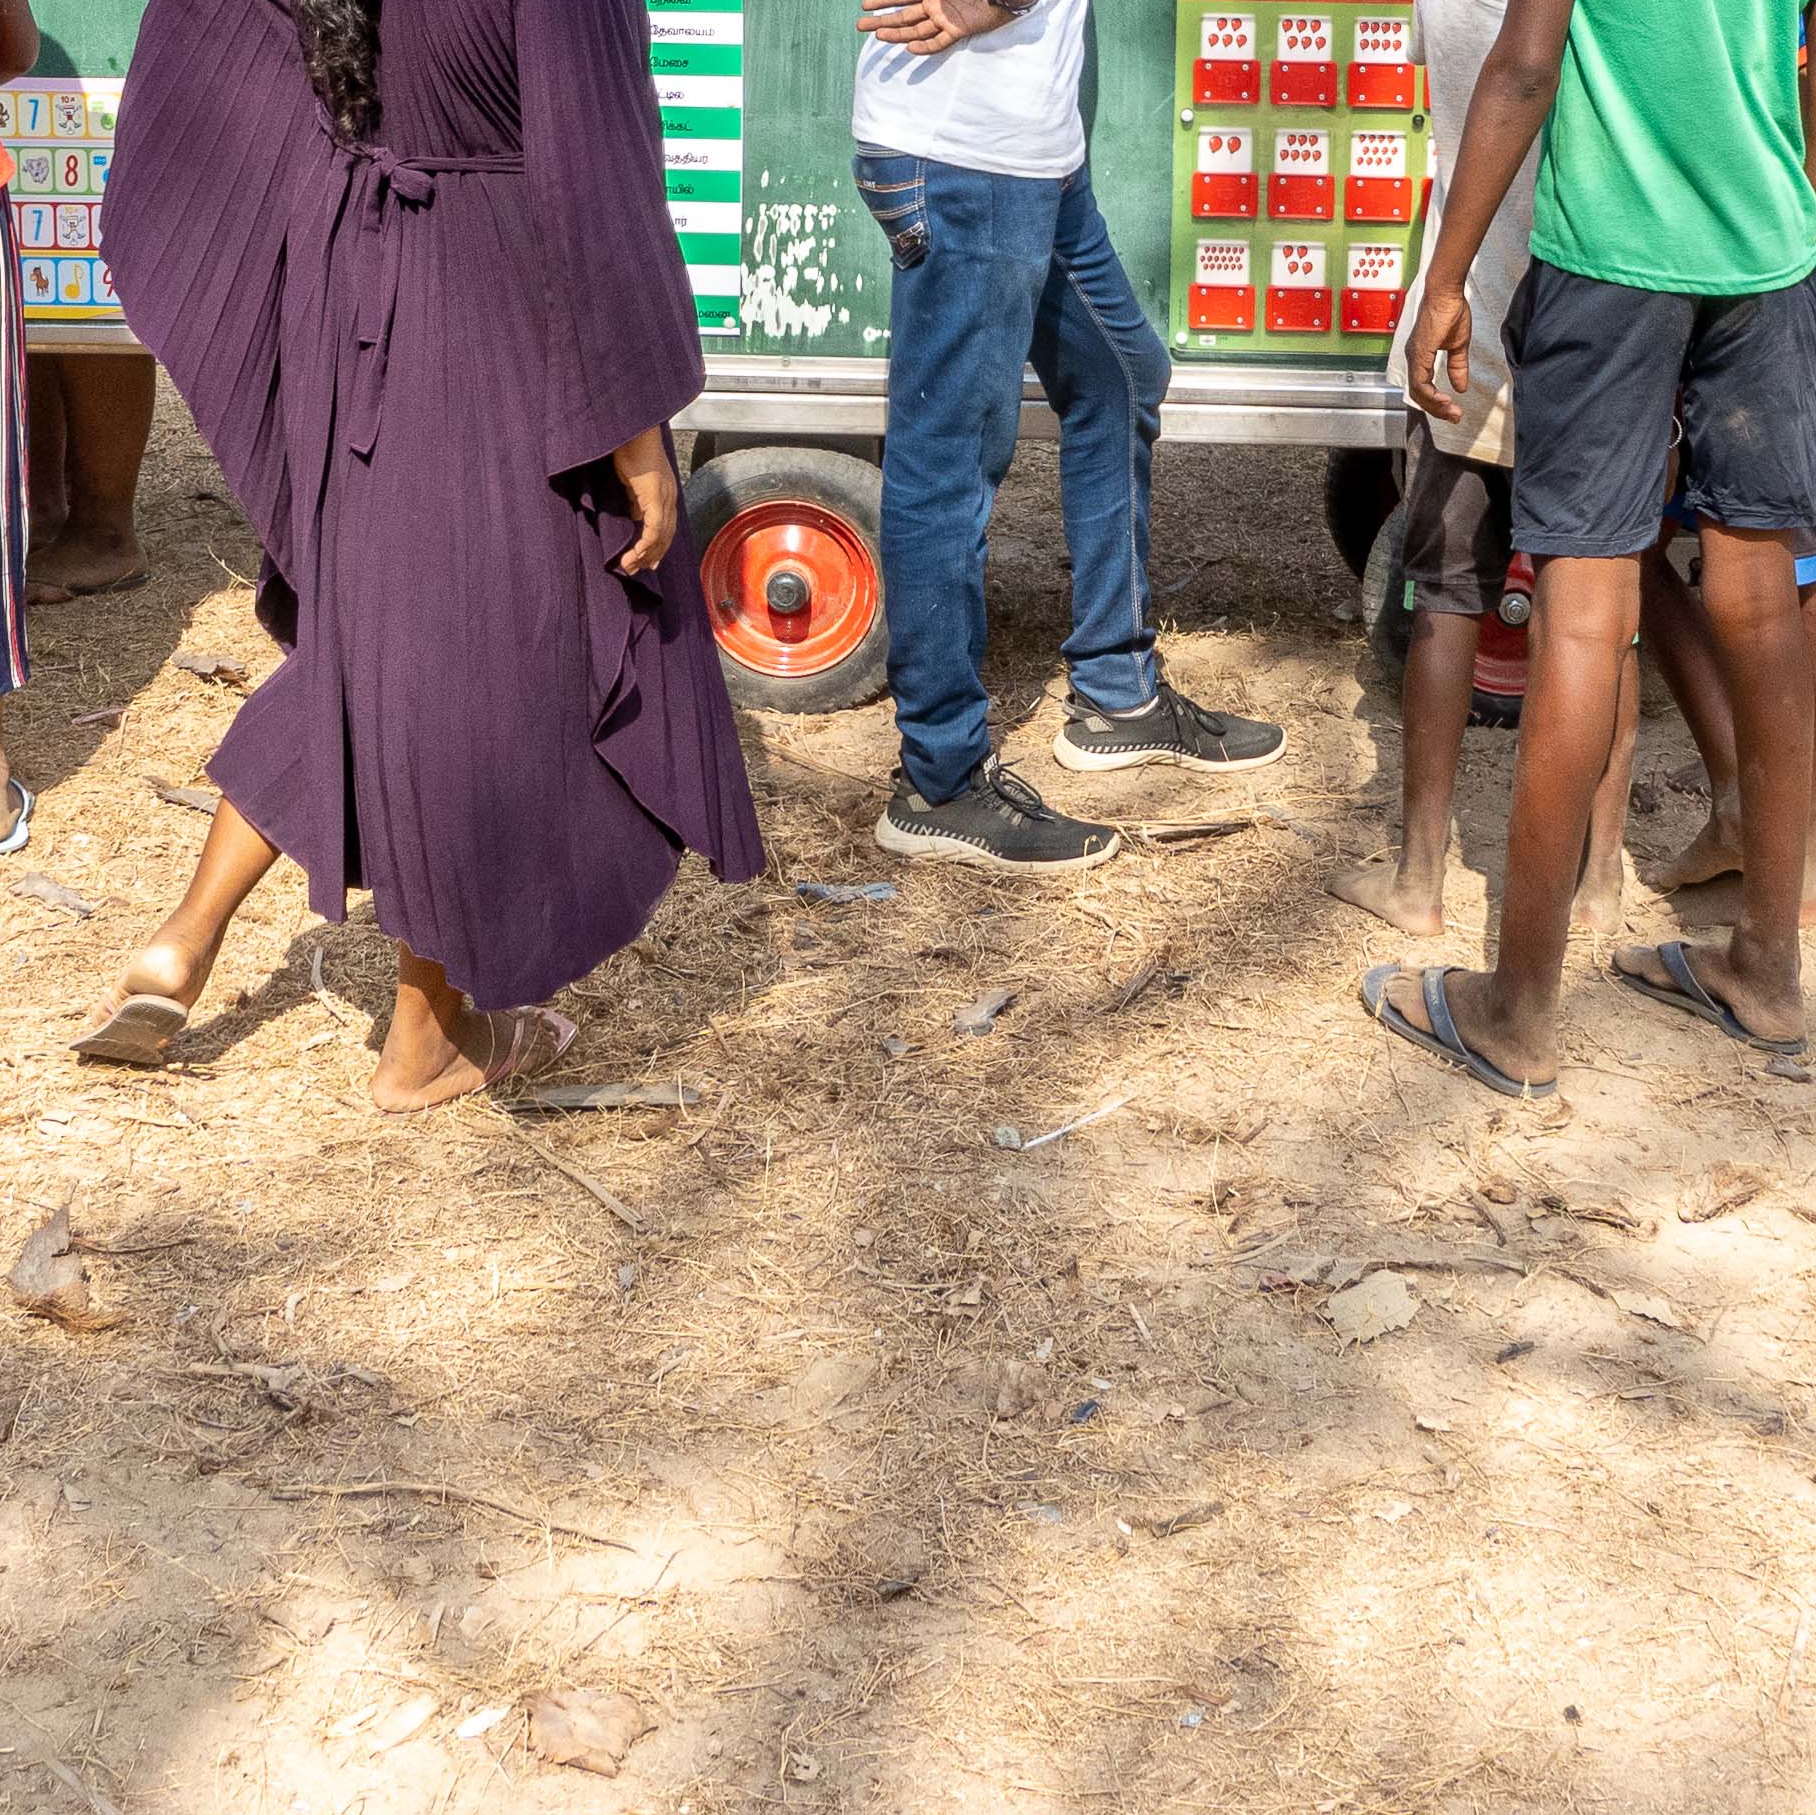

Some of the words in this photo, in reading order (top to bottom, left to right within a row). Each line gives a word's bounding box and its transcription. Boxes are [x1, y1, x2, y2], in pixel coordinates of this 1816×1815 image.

[28, 99, 39, 131] 7
[64, 154, 78, 187] 8
[32, 210, 43, 241] 7
